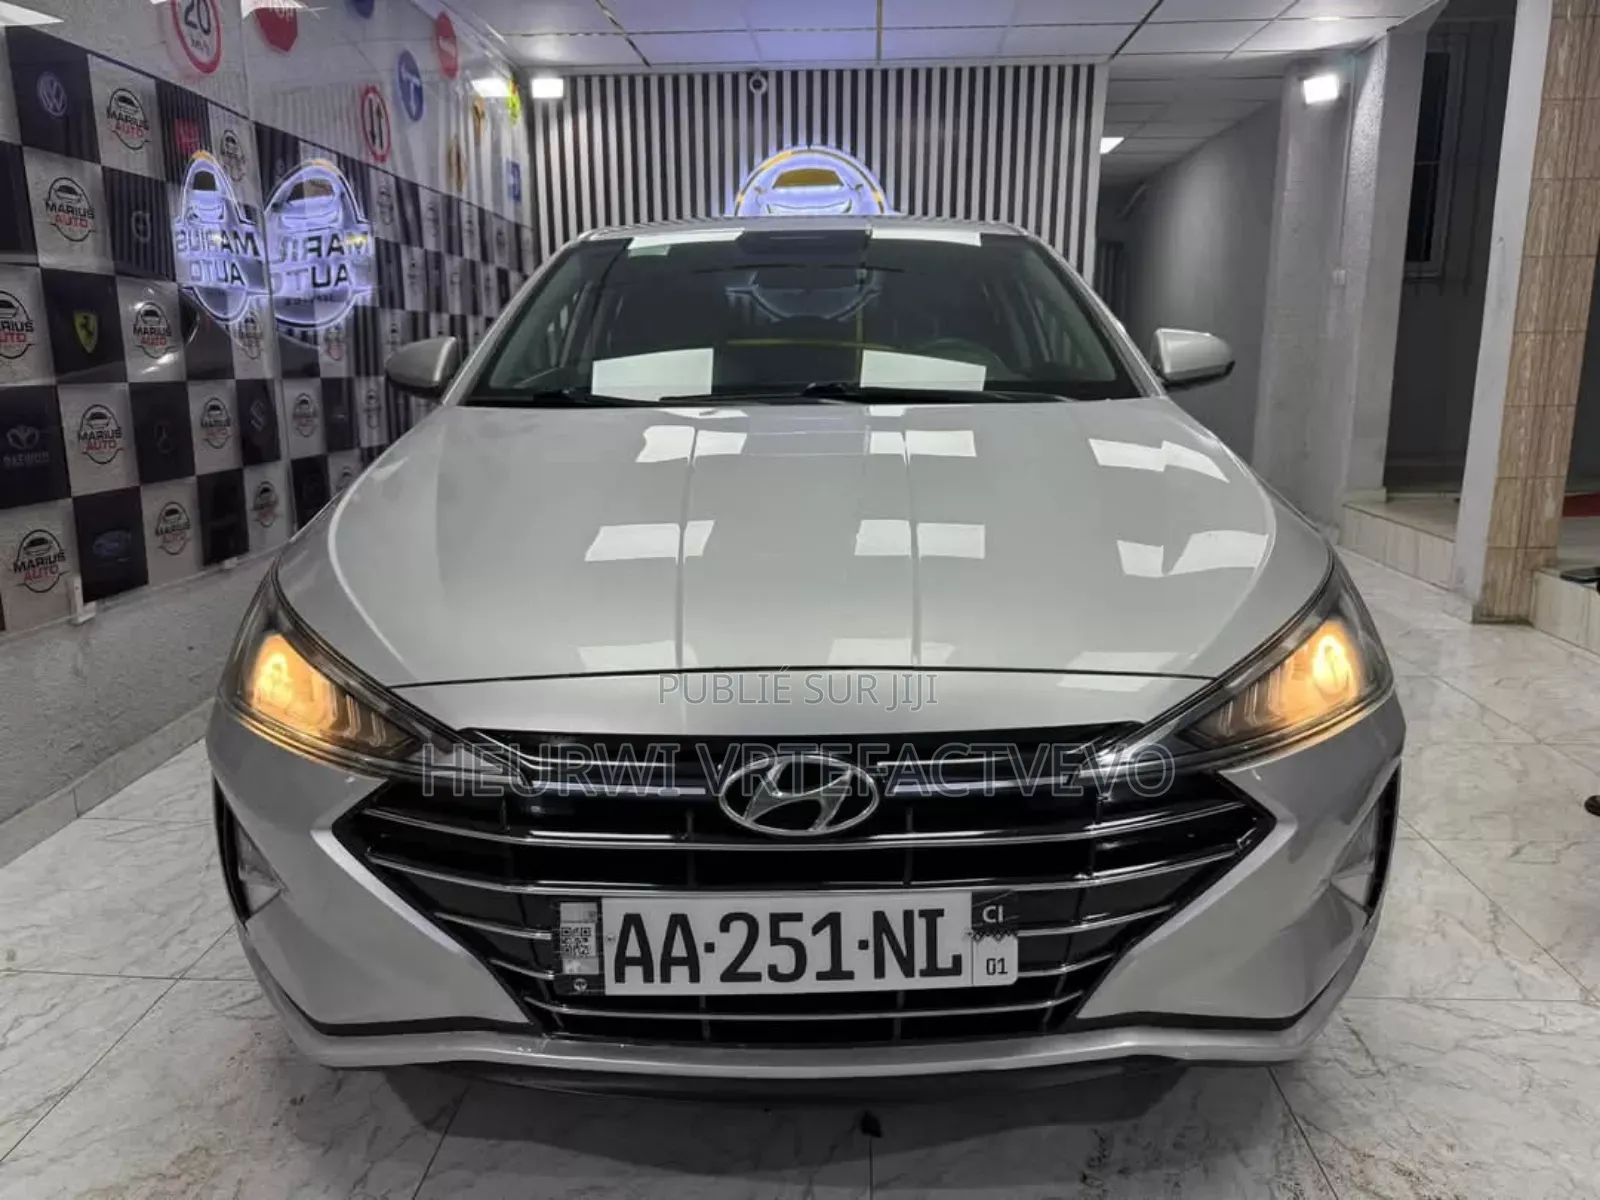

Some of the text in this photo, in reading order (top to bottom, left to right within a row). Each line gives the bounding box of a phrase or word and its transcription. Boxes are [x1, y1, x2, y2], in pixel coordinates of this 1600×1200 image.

[115, 121, 145, 138] AUTO
[45, 200, 95, 219] MARIUS
[55, 213, 89, 229] AUTO
[0, 320, 35, 333] RIUS
[133, 324, 172, 337] MARIUS
[0, 332, 26, 343] UTO
[77, 427, 122, 441] MARIUS
[86, 440, 118, 451] AUTO
[12, 549, 66, 573] MARIUS
[24, 563, 59, 581] AUTO
[982, 905, 1004, 923] CI
[986, 957, 1008, 975] 01
